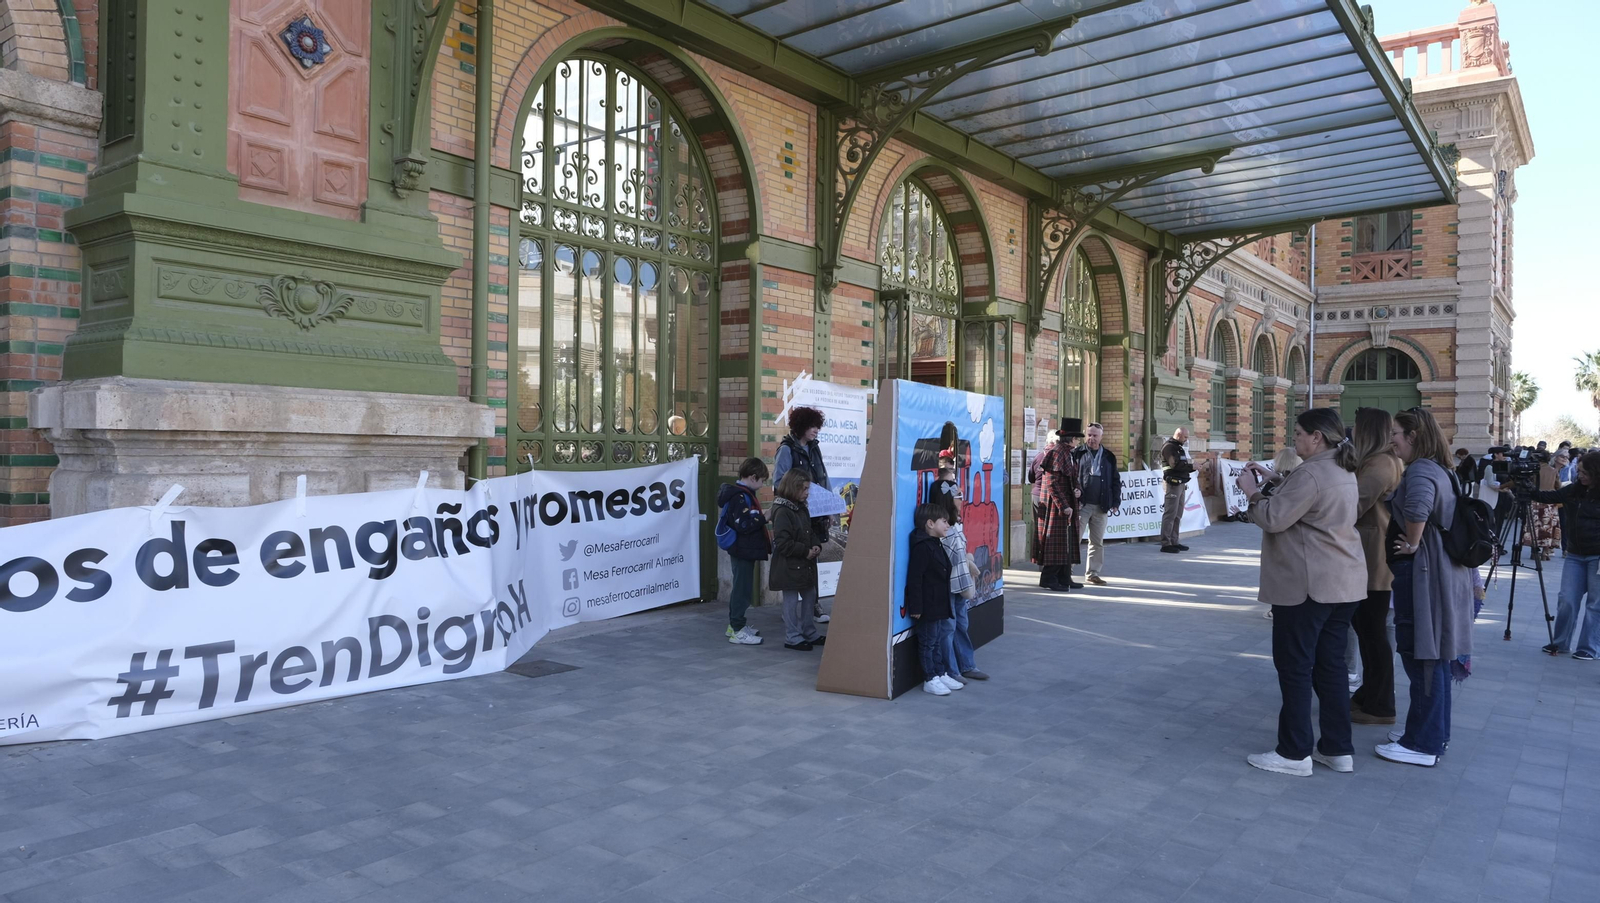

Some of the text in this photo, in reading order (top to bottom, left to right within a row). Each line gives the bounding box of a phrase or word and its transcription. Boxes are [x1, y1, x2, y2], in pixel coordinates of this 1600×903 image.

[840, 420, 858, 430] MESA
[817, 433, 861, 445] FERROCARRIL
[1129, 478, 1145, 488] DEL
[1120, 489, 1154, 501] LMERÍA
[1122, 505, 1141, 516] VÍAS
[1143, 505, 1157, 514] DE
[1106, 523, 1136, 534] QUIERE
[135, 520, 240, 591] de
[260, 502, 500, 580] engaños
[510, 499, 521, 550] y
[583, 533, 660, 557] @MesaFerrocarril
[583, 553, 684, 582] Mesa Ferrocarril Almería
[587, 579, 680, 608] mesaferrocarrilalmería
